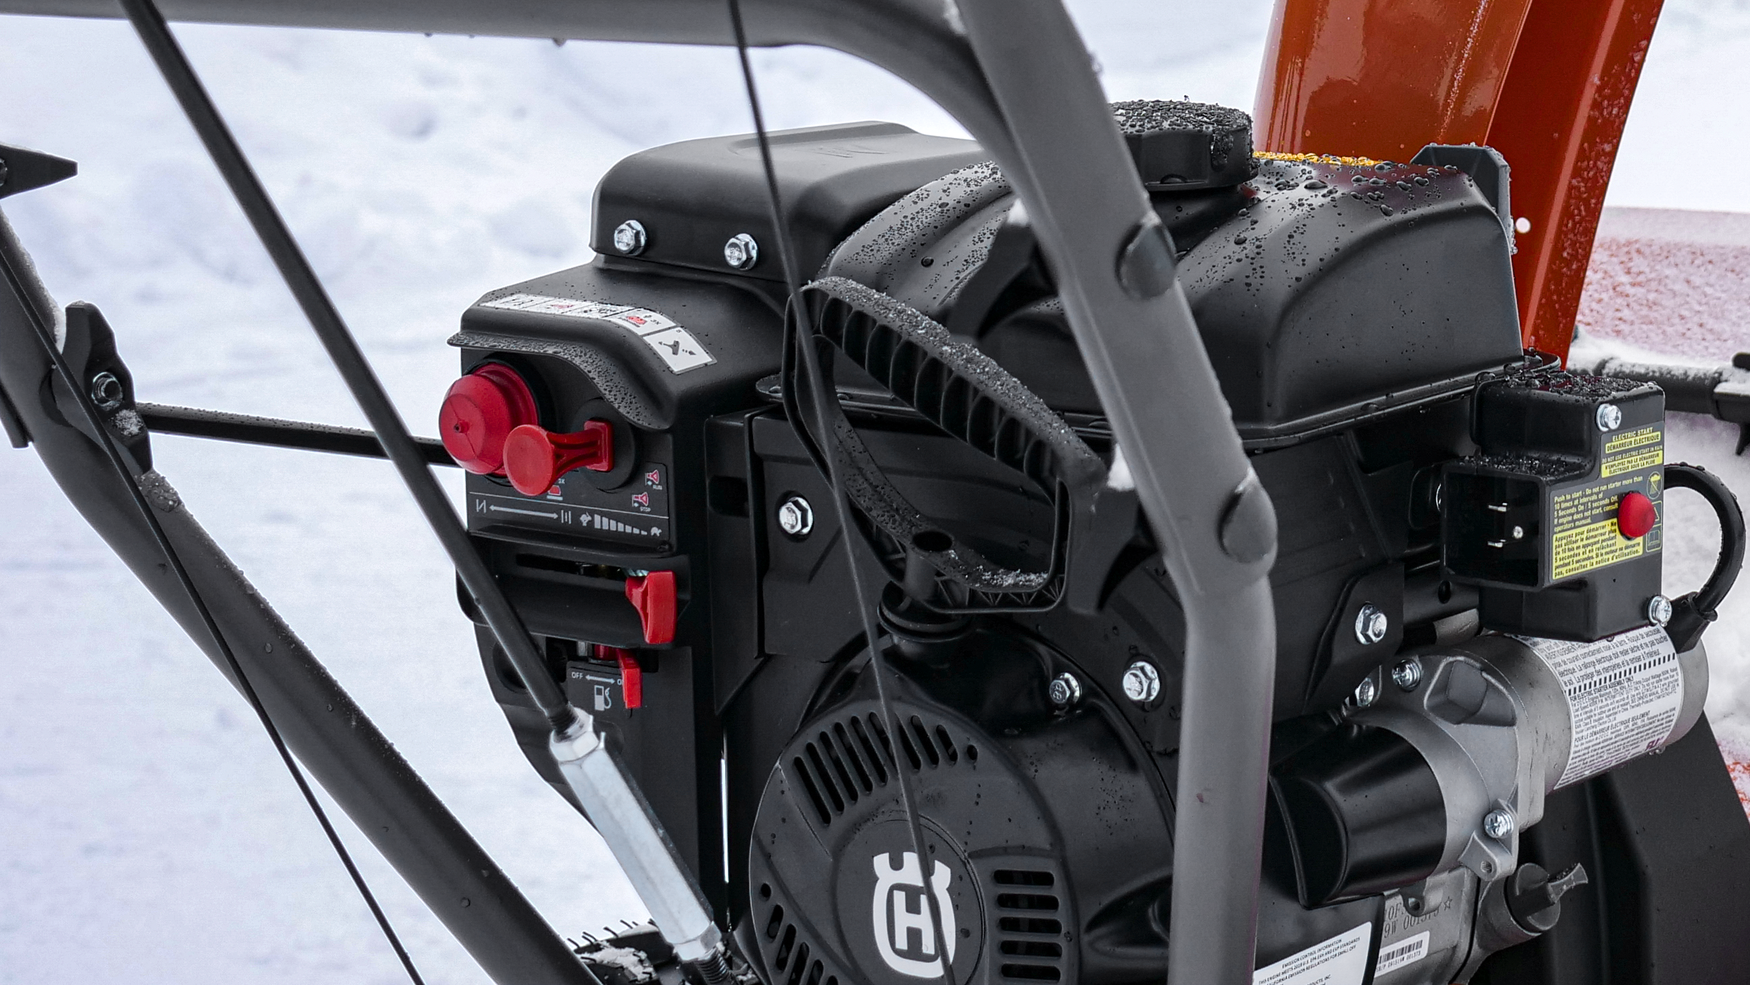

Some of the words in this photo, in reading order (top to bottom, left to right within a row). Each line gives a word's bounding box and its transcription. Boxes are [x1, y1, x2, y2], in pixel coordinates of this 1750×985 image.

[1612, 431, 1636, 441] ELECTRIC
[1638, 427, 1653, 435] START
[1317, 939, 1342, 953] INFORMATION
